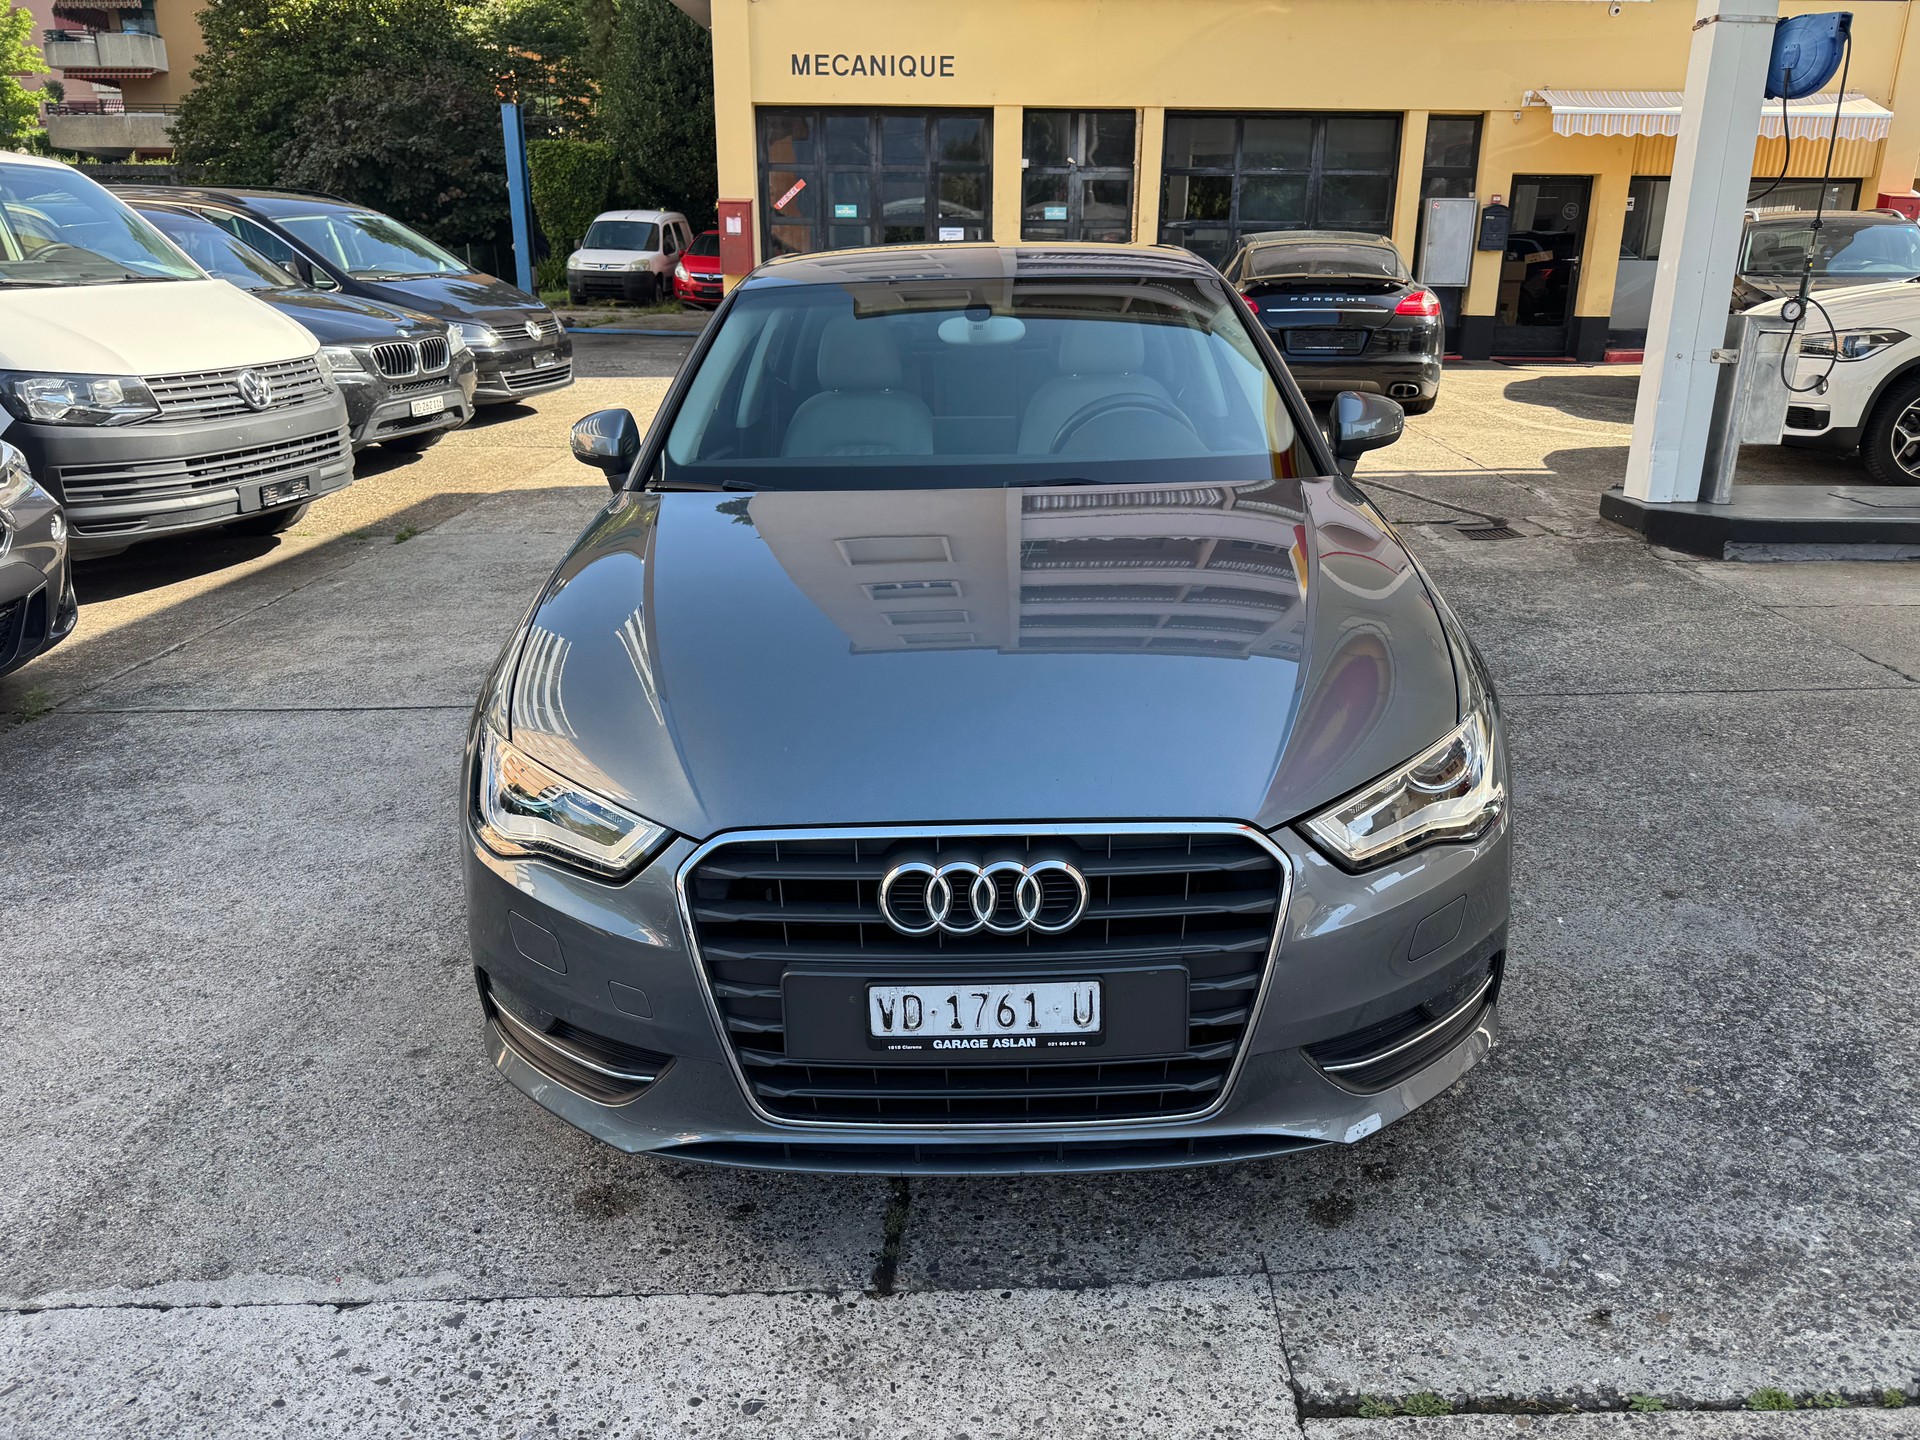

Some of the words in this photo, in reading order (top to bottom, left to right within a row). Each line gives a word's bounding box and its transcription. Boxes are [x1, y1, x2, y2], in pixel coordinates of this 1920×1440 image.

[792, 54, 954, 77] MECANIQUE
[876, 992, 924, 1032] VD
[947, 991, 1041, 1030] 1761
[1072, 987, 1095, 1028] U
[933, 1039, 988, 1049] GARAGE
[992, 1038, 1036, 1048] ASLAN
